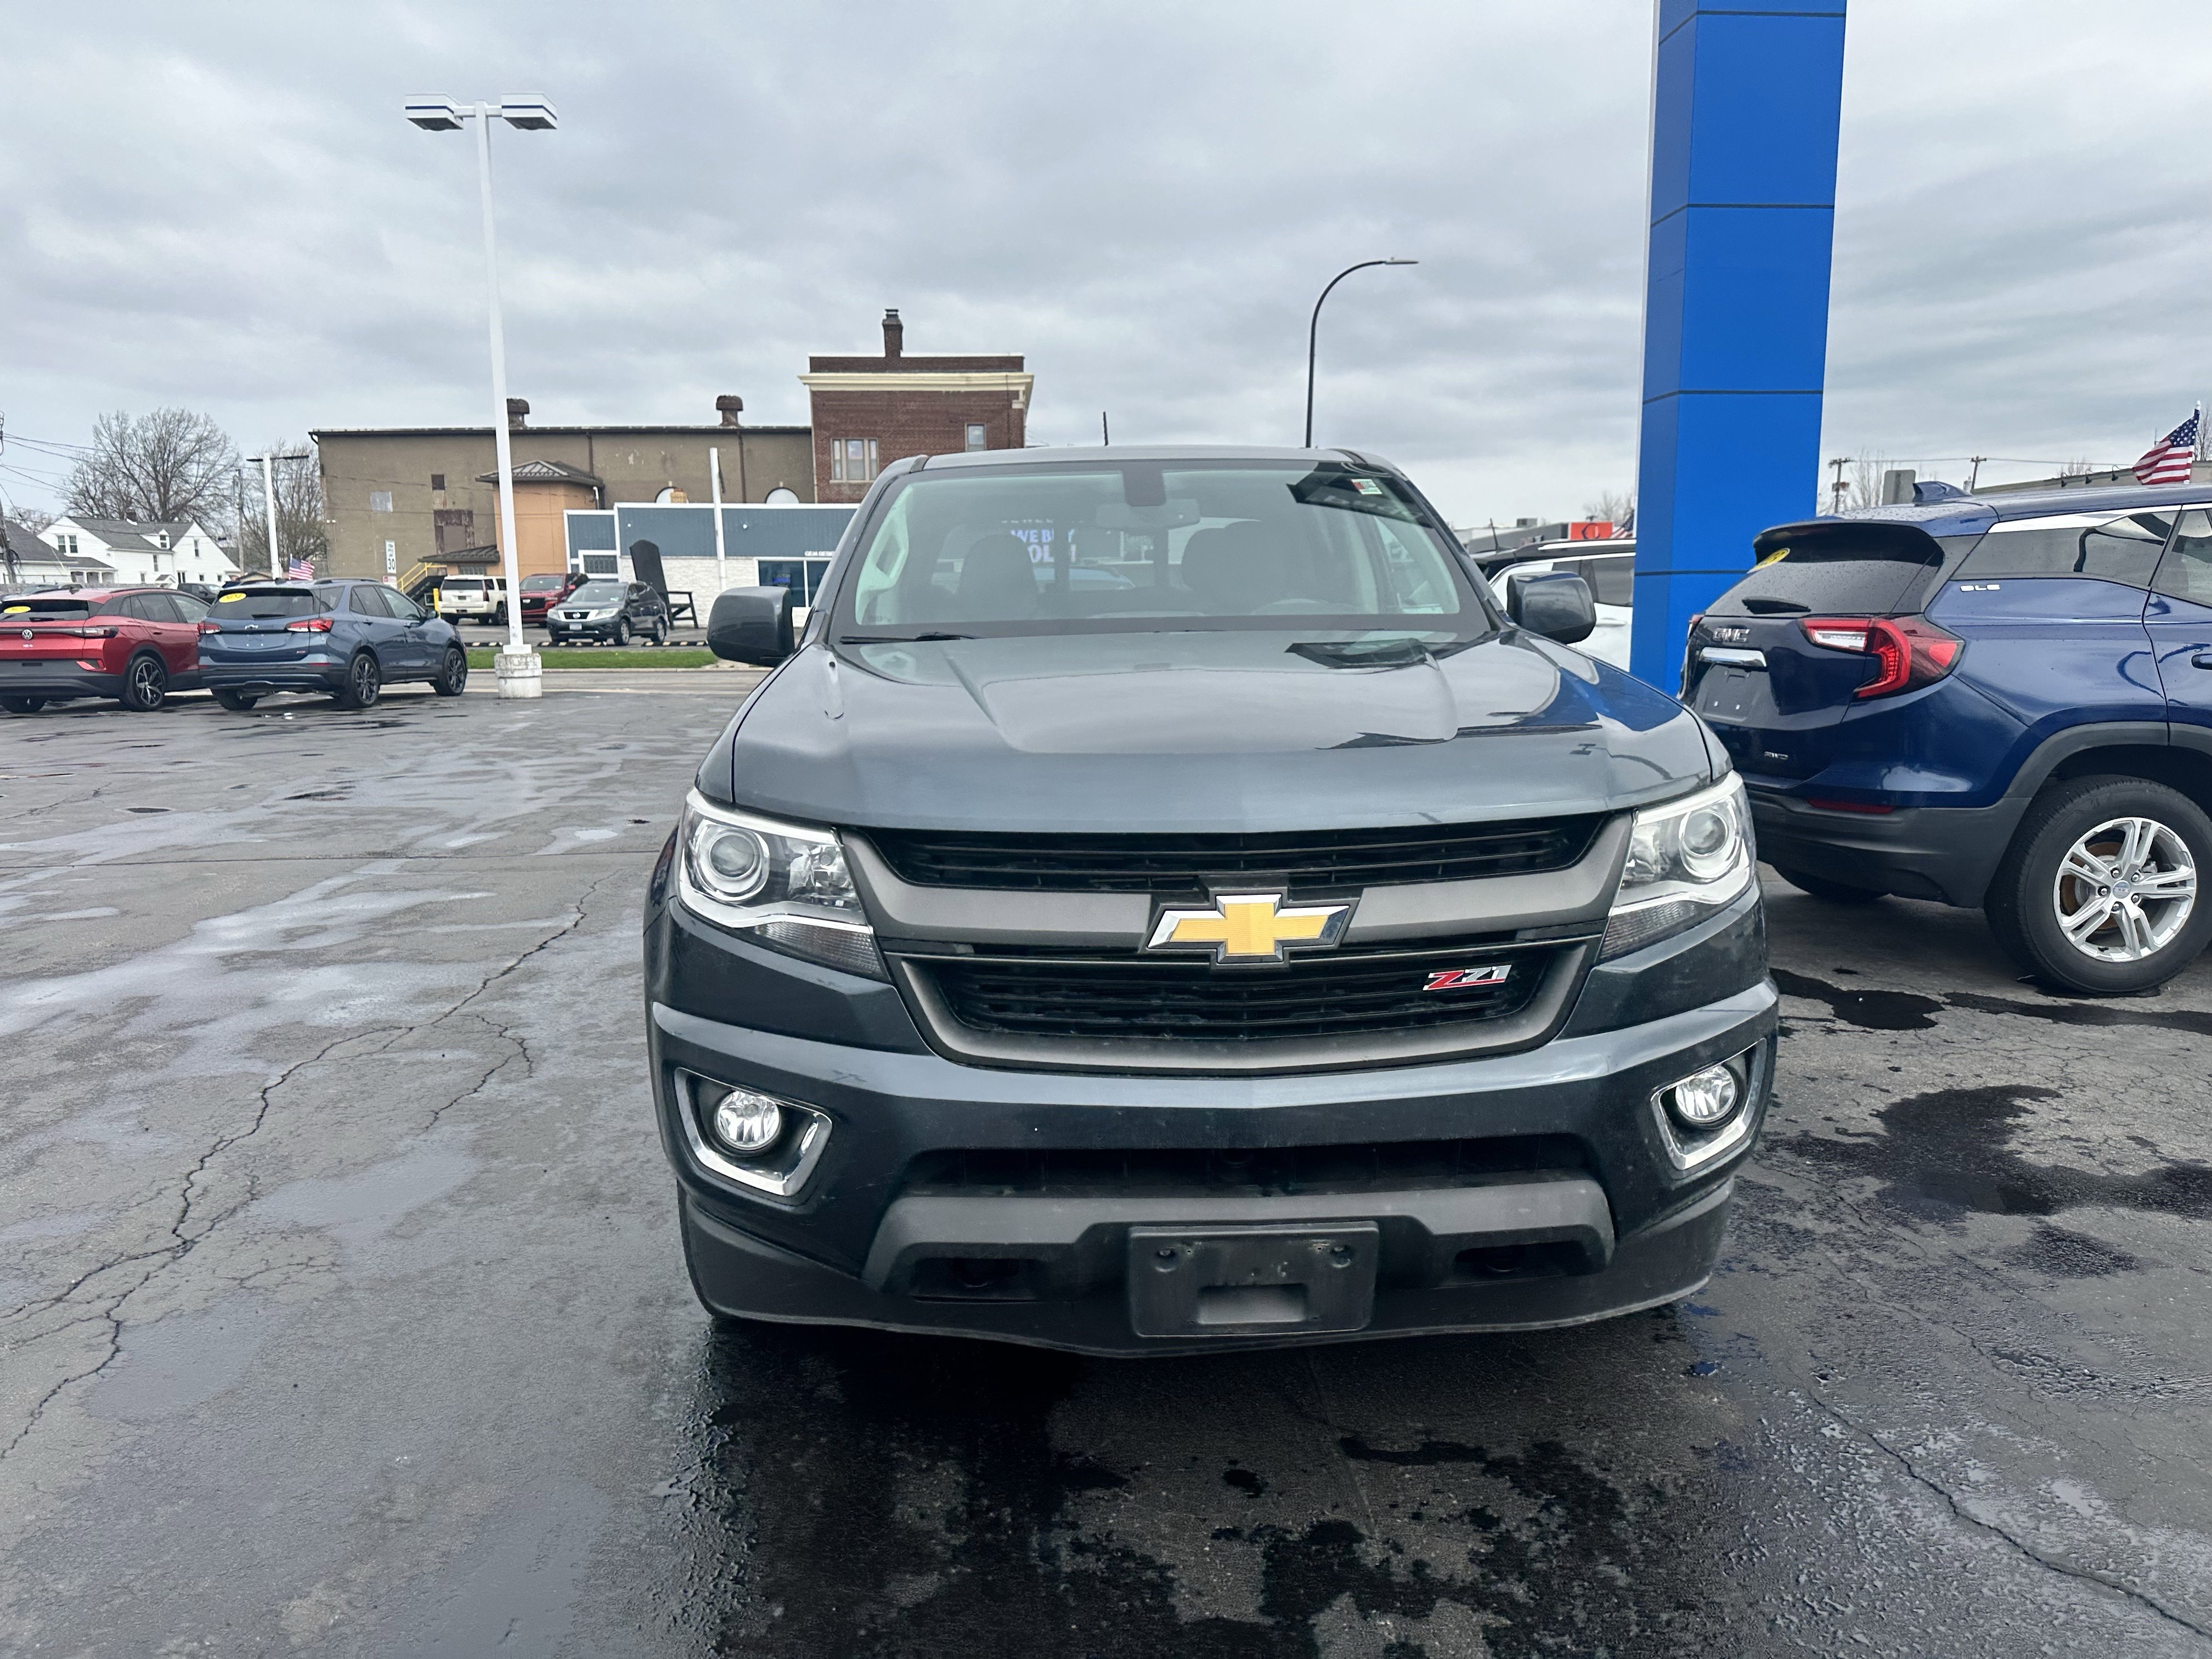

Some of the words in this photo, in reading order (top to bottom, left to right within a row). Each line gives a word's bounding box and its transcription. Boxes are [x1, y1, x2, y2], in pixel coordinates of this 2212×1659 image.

[1009, 529, 1039, 543] WE
[388, 558, 396, 571] 30
[1713, 628, 1750, 642] GMC
[1423, 964, 1512, 991] Z71
